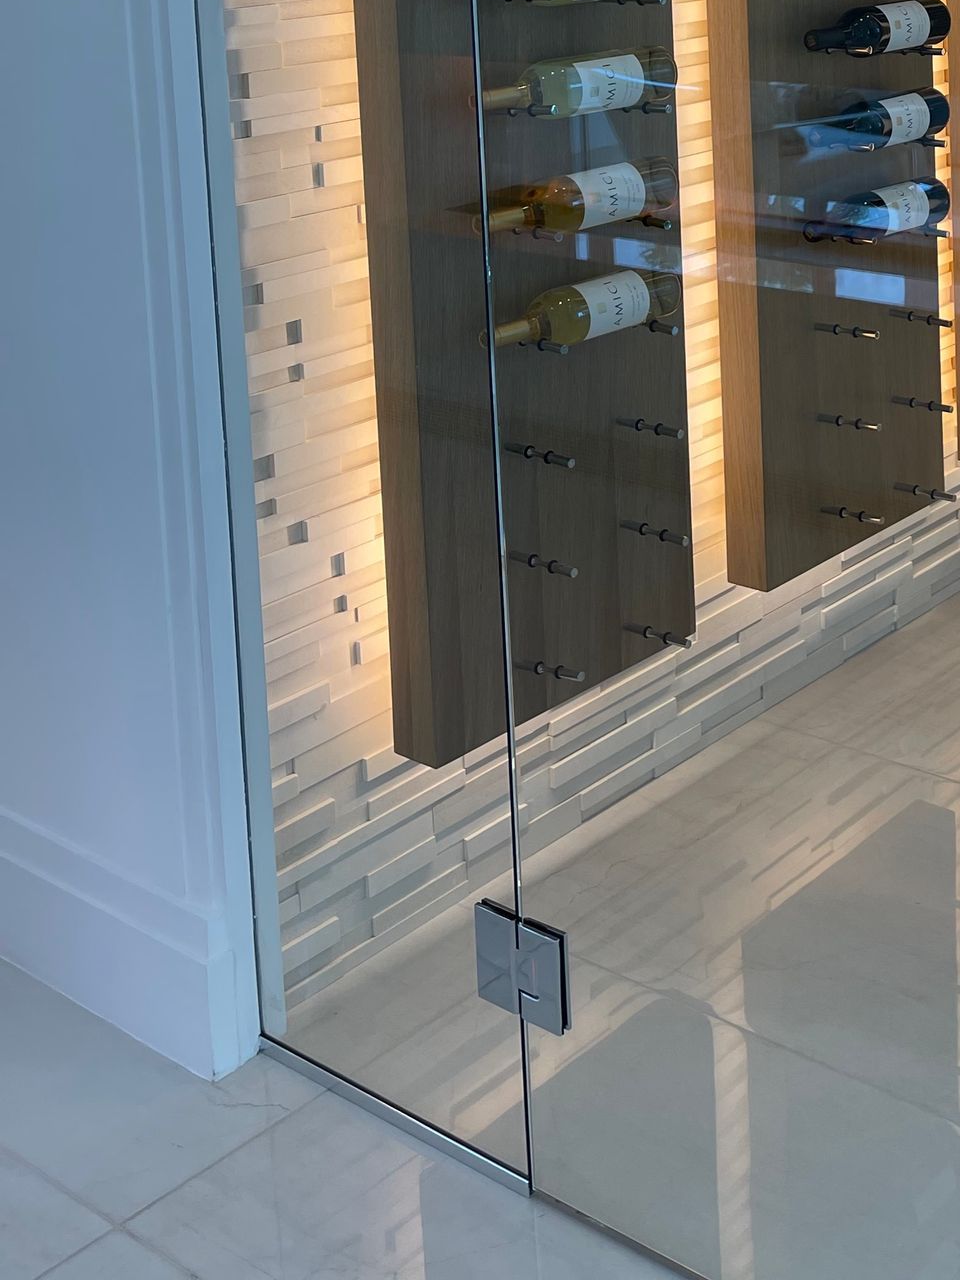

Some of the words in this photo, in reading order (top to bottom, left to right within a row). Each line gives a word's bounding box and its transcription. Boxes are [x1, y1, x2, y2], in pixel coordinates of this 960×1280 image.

[602, 64, 617, 108] AMICI
[599, 172, 618, 217] AMICI
[603, 281, 623, 325] AMICI
